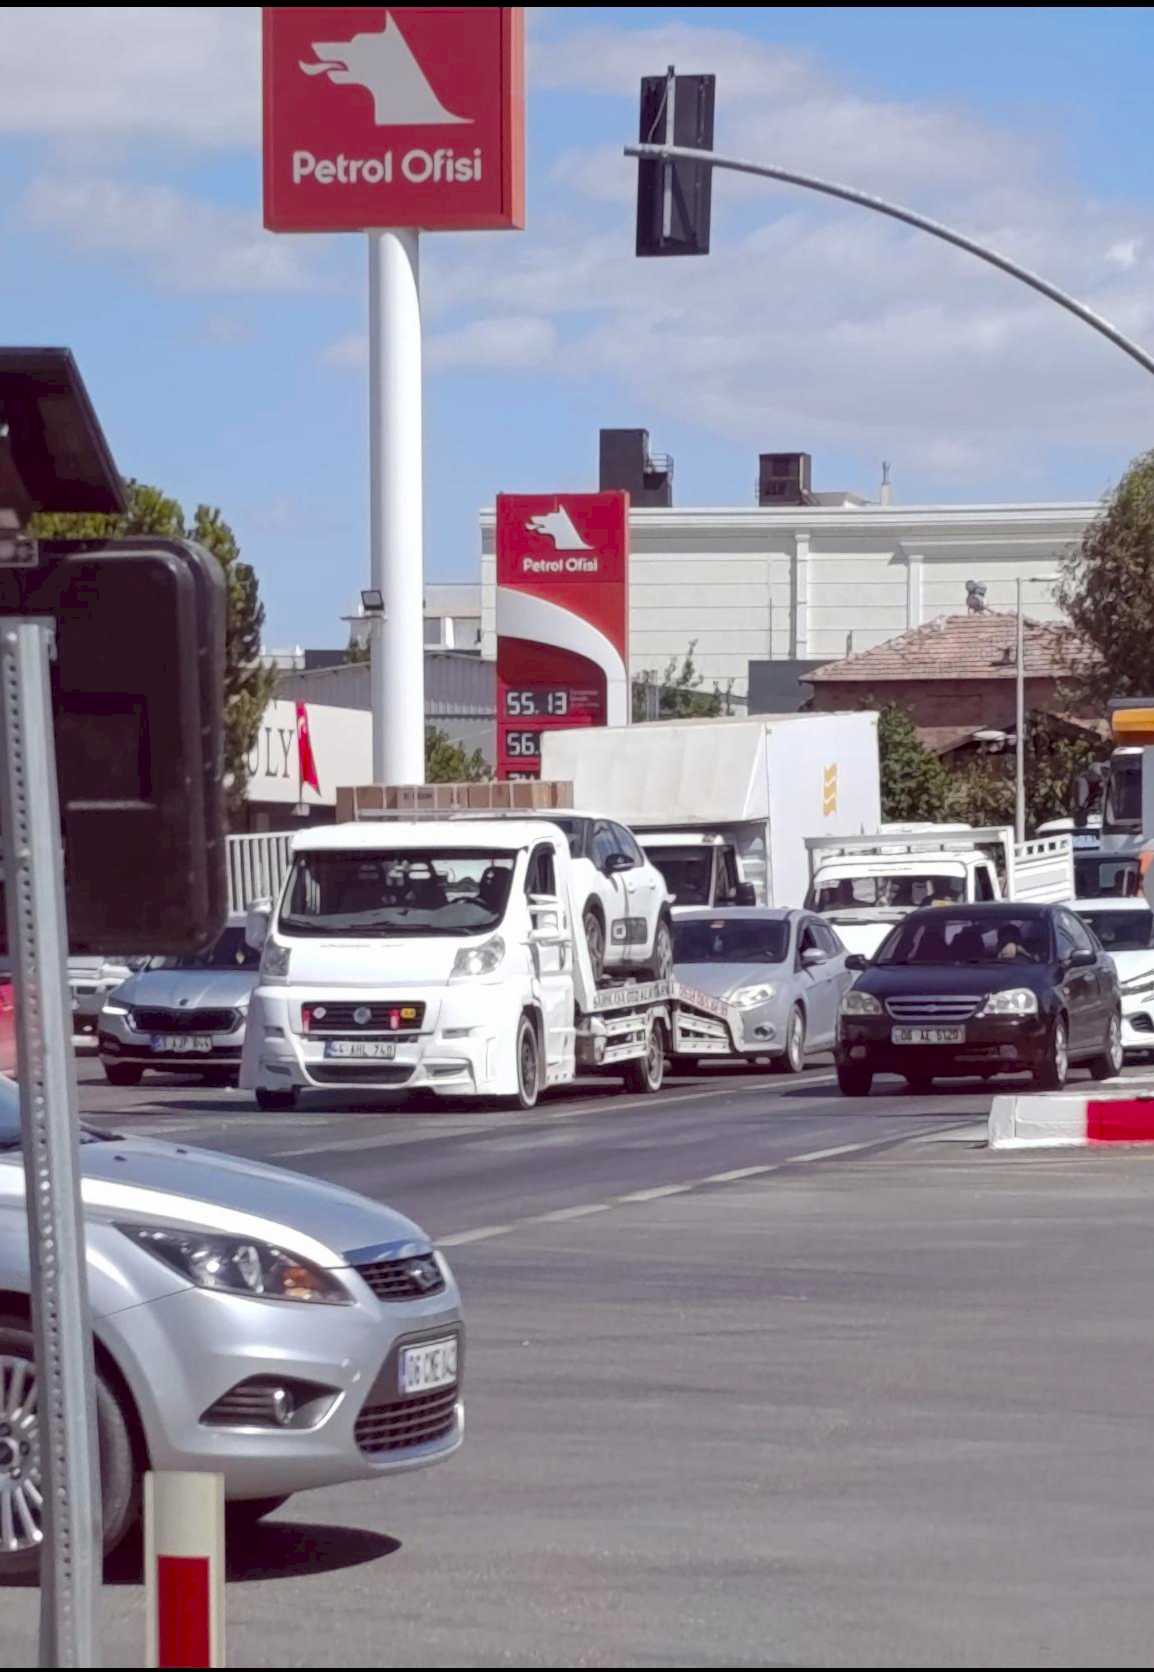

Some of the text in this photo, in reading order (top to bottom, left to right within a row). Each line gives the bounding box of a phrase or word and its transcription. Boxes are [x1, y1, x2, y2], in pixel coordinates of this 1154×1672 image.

[293, 147, 482, 184] Petrol Ofisi
[523, 557, 598, 572] Petrol Ofisi
